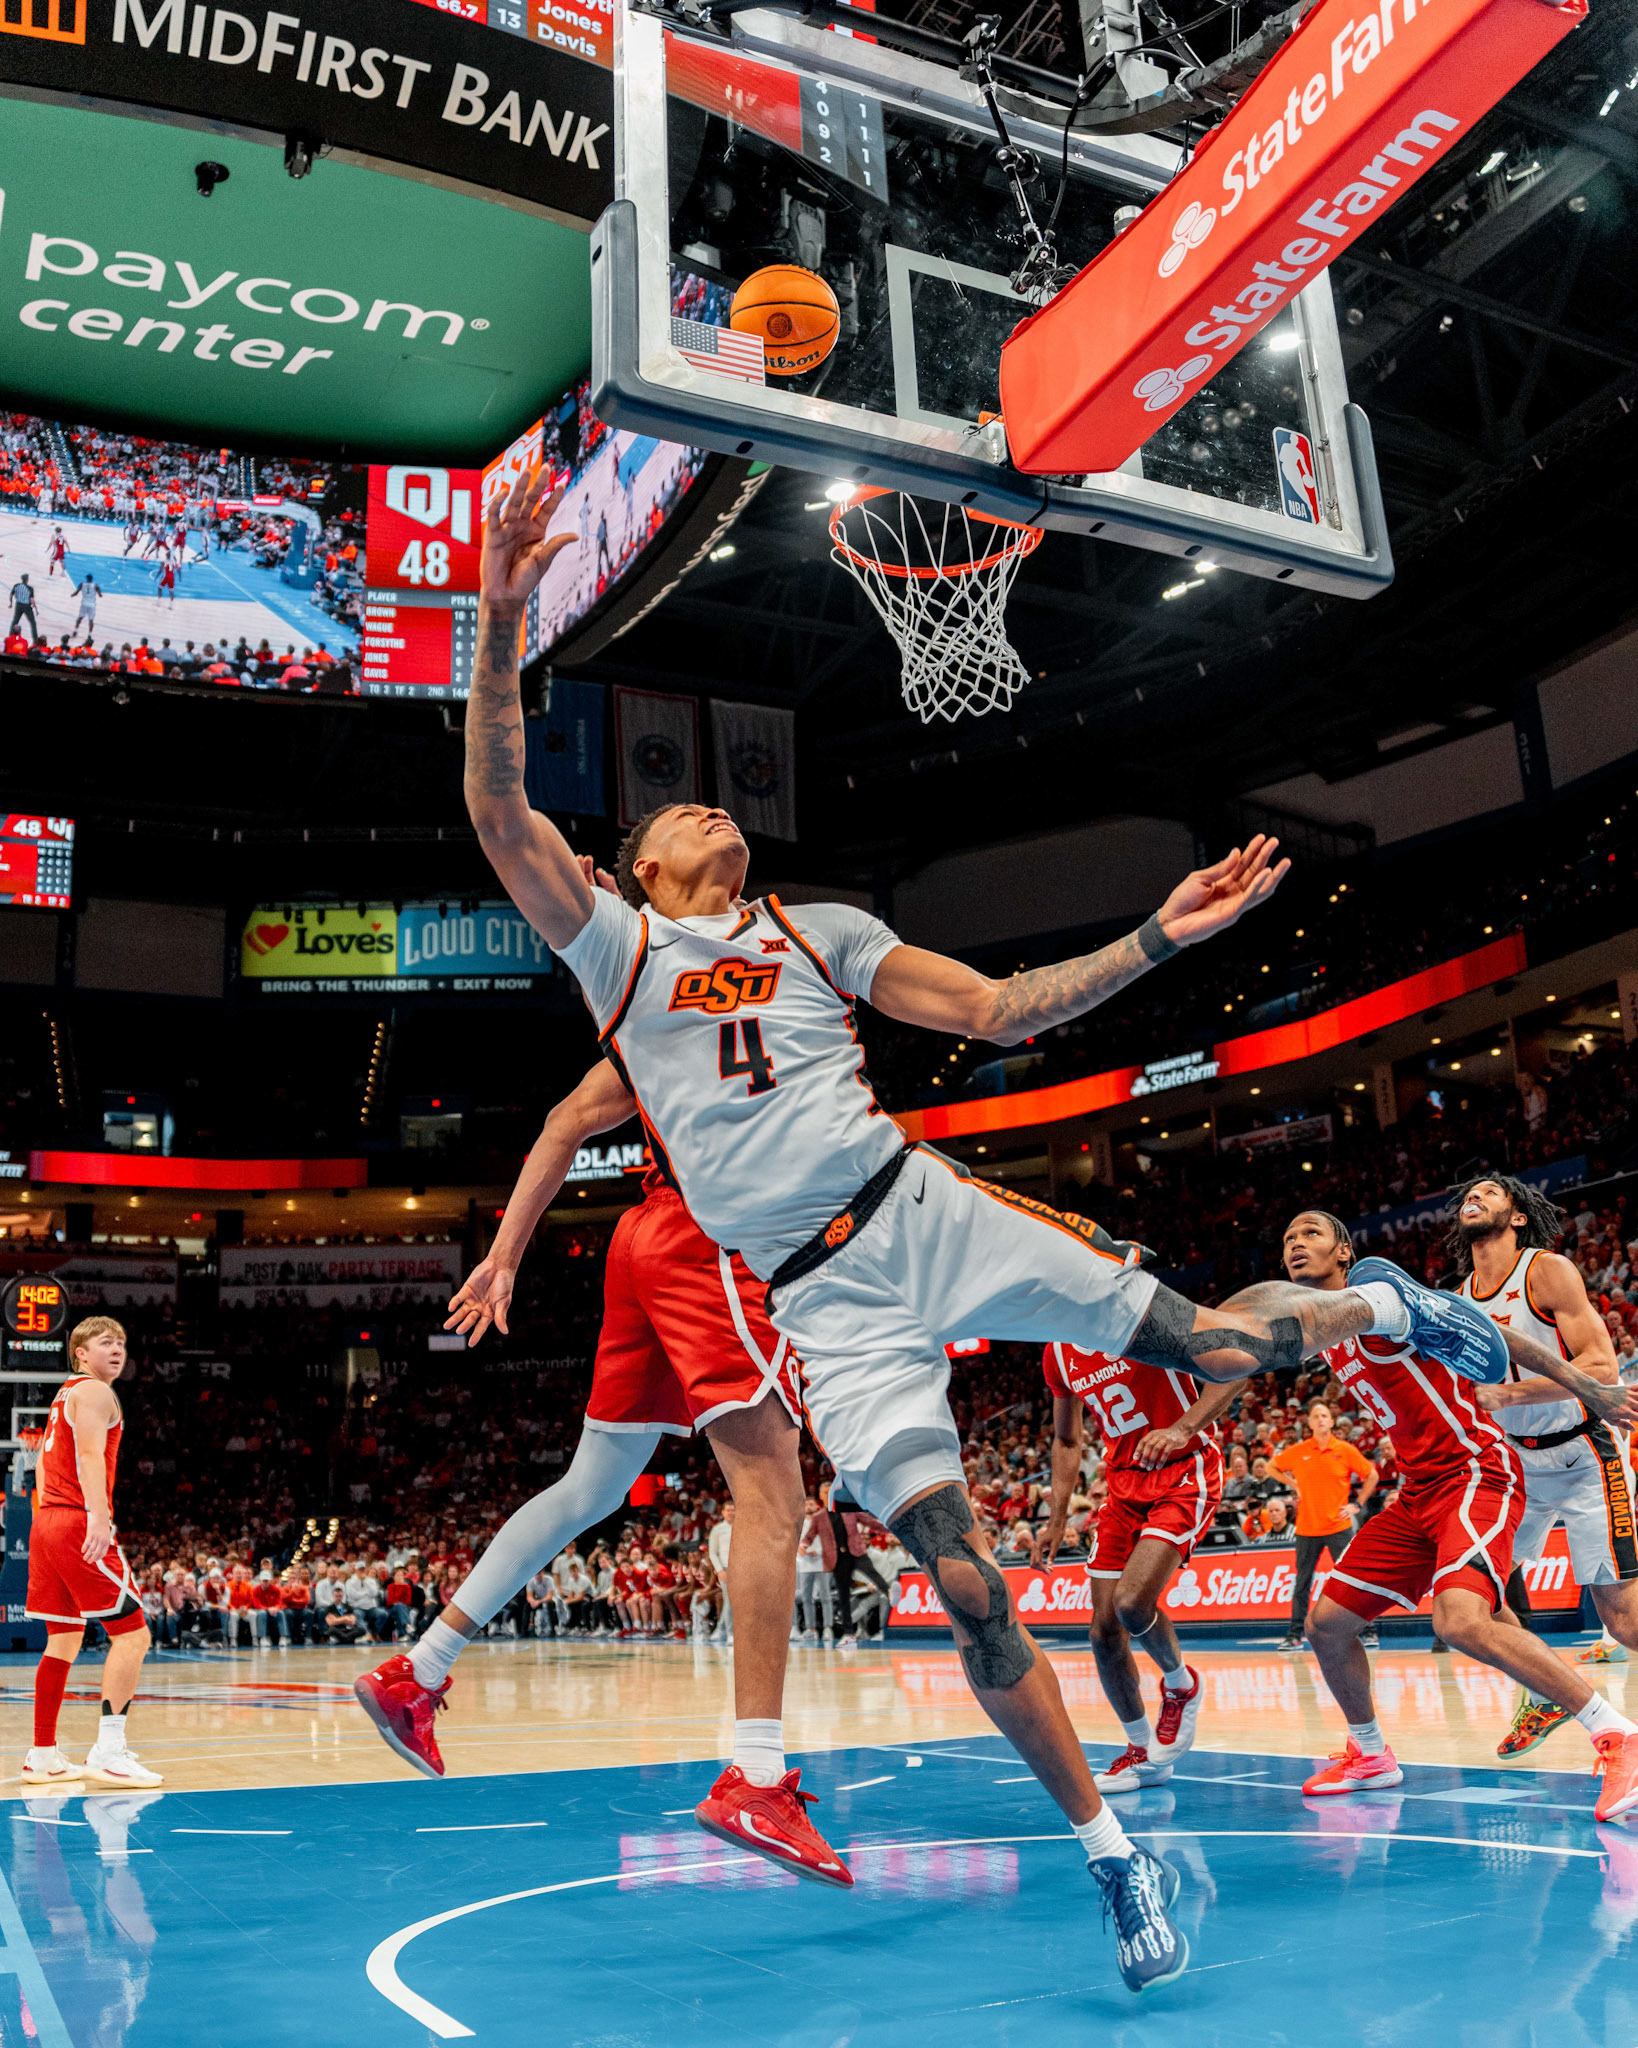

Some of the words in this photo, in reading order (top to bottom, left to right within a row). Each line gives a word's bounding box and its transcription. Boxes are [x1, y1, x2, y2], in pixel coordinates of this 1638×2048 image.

[497, 8, 521, 29] 13
[538, 0, 603, 36] Jones
[537, 22, 598, 58] Davis
[442, 63, 610, 170] BANK
[19, 299, 334, 375] center
[764, 350, 820, 368] ilson
[1288, 500, 1308, 519] NBA
[397, 540, 450, 586] 48
[367, 591, 397, 603] PLAYER
[366, 606, 396, 618] BROWN
[454, 611, 465, 621] 10
[365, 622, 394, 633] WAGUE
[455, 626, 463, 636] 4
[364, 653, 389, 664] JONES
[13, 819, 41, 837] 48
[404, 917, 475, 966] LOUD
[486, 917, 545, 963] CITY
[262, 980, 312, 992] BRING
[316, 980, 349, 992] THE
[351, 979, 430, 991] THUNDER
[453, 978, 490, 991] EXIT
[495, 978, 532, 989] NOW
[668, 956, 782, 1015] OSU
[718, 1017, 777, 1096] 4
[1145, 1055, 1190, 1075] PRESENTED
[1191, 1051, 1204, 1063] BY
[566, 1143, 643, 1170] DLAM
[244, 1262, 278, 1278] POST
[328, 1260, 374, 1277] PARTY
[20, 1285, 60, 1305] 14:02
[16, 1301, 50, 1332] 3.3
[22, 1340, 64, 1352] TISSOT
[1071, 1360, 1132, 1393] OKLAHOMA
[1084, 1382, 1149, 1438] 12
[1349, 1379, 1397, 1430] 13
[1605, 1459, 1633, 1538] COWBOYS
